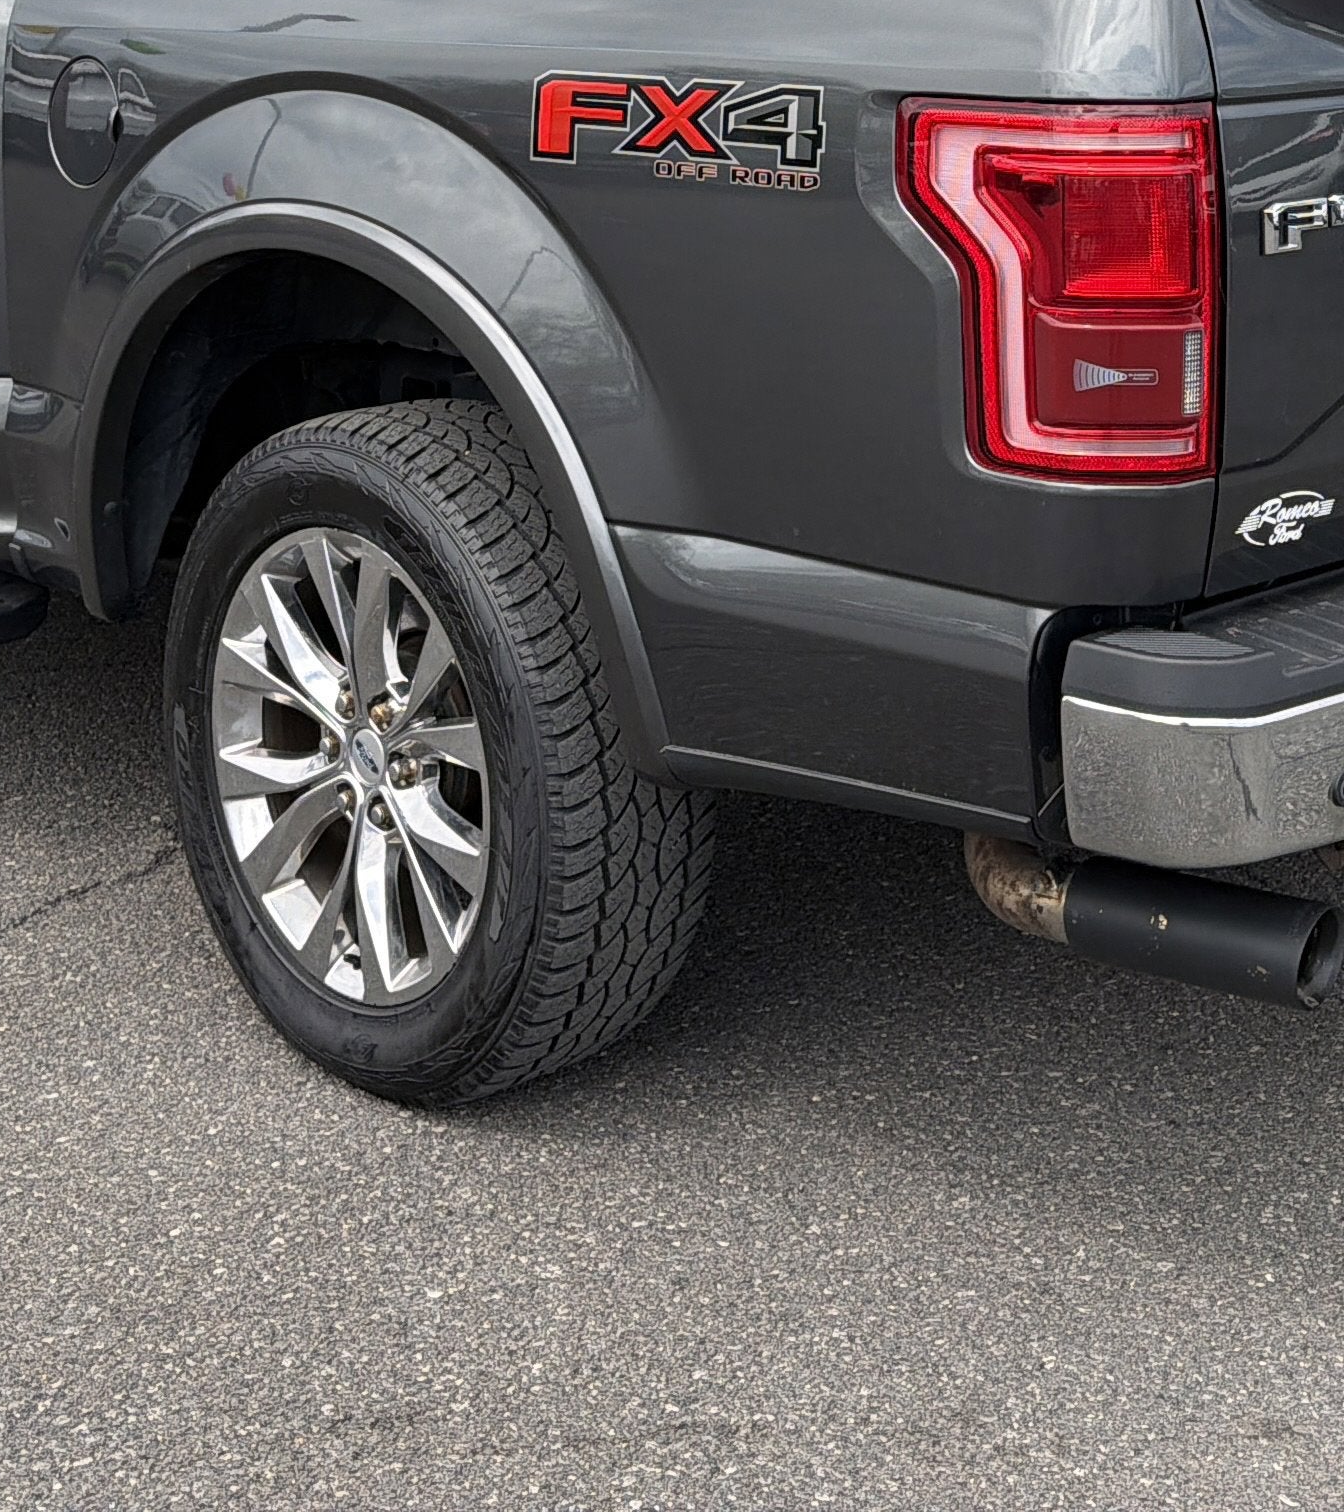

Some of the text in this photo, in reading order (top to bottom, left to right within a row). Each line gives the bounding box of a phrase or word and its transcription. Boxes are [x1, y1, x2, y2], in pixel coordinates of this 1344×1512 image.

[530, 69, 826, 172] FX4
[654, 160, 820, 192] OFF ROAD
[1249, 497, 1320, 528] Romeo
[1269, 521, 1305, 545] Ford
